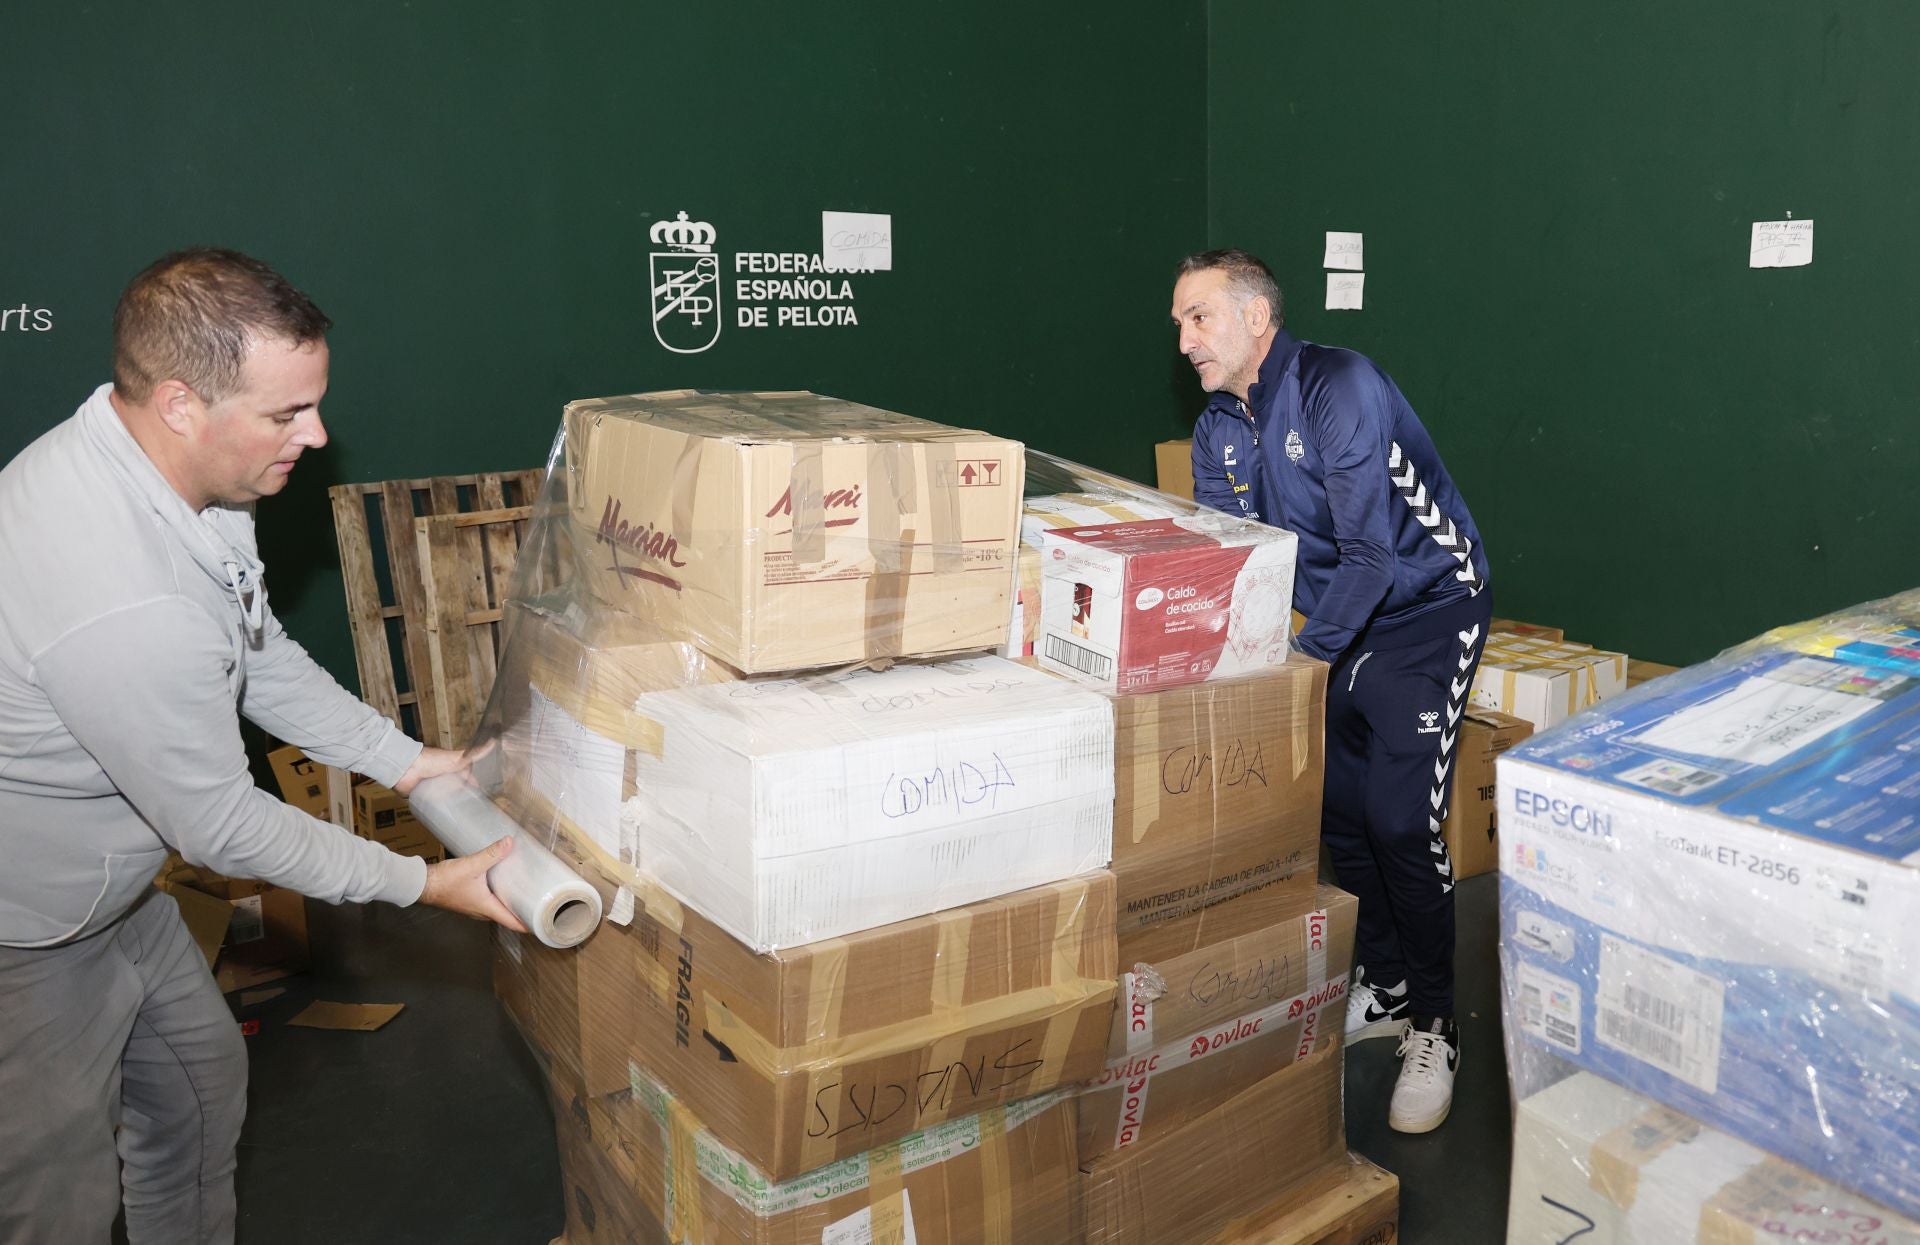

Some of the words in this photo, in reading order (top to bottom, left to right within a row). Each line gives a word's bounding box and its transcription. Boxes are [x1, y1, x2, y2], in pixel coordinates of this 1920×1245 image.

[829, 230, 889, 249] COMIDA
[735, 252, 875, 273] FEDERA
[736, 276, 854, 300] ESPAÑOLA
[0, 303, 53, 331] rts
[737, 307, 768, 327] DE
[778, 306, 858, 327] PELOTA
[1166, 602, 1179, 615] de
[1181, 597, 1214, 613] cocido
[1167, 586, 1196, 600] Caldo
[1162, 736, 1267, 795] COMIDA
[881, 752, 1015, 818] COMIDA
[1515, 788, 1613, 838] EPSON
[1655, 830, 1713, 861] EcoTank
[1717, 846, 1801, 886] ET-2856
[1127, 888, 1186, 913] MANTENER
[1187, 884, 1200, 898] LA
[1202, 873, 1238, 896] CADENA
[1240, 868, 1252, 881] DE
[1310, 909, 1326, 952] lac
[1306, 979, 1347, 1011] ovlac
[1211, 1017, 1263, 1050] ovlac
[1298, 1013, 1316, 1061] ovla
[1102, 1055, 1160, 1085] ovlac
[1119, 1097, 1140, 1150] ovla
